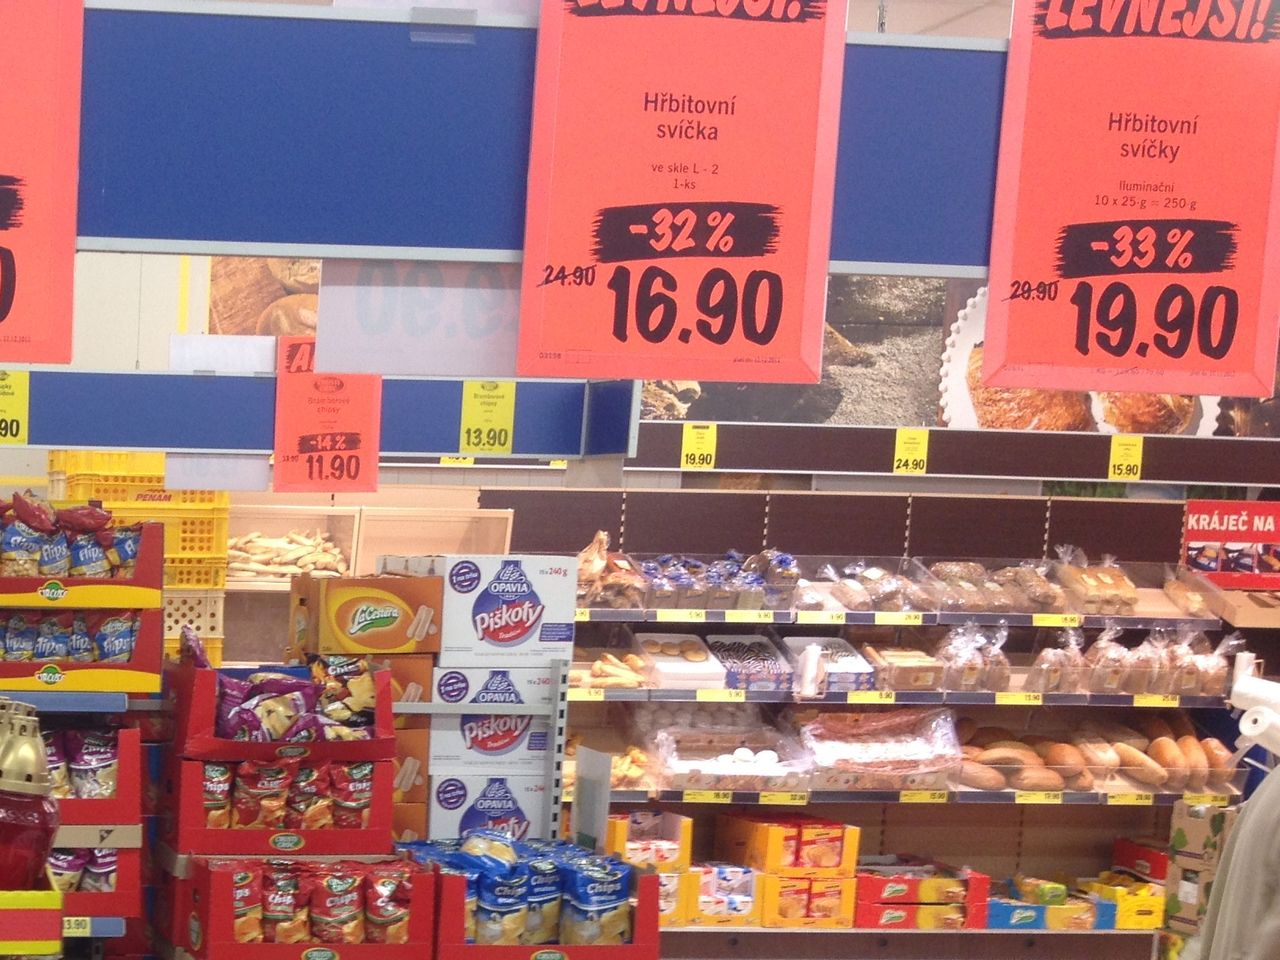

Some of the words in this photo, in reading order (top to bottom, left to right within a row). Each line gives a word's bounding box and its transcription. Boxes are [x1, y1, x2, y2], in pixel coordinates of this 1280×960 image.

[644, 92, 737, 116] Hřbitovní
[656, 119, 718, 141] svíčka
[1108, 112, 1199, 135] Hřbitovní
[1120, 139, 1180, 163] svíčky
[651, 165, 664, 174] ve
[667, 162, 689, 174] skle
[693, 163, 699, 174] L
[711, 164, 719, 175] 2
[1094, 195, 1109, 206] 10
[629, 208, 697, 252] -32
[706, 211, 734, 252] %
[1090, 225, 1157, 268] -33
[1165, 228, 1195, 269] %
[544, 264, 597, 287] 24.90
[607, 265, 783, 345] 16.90
[1070, 281, 1239, 360] 19.90
[465, 427, 508, 448] 13.90
[306, 454, 361, 481] 11.90
[685, 453, 712, 466] 19.90
[895, 458, 925, 470] 24.90
[1112, 463, 1139, 477] 15.90
[135, 493, 172, 502] PENAM
[1188, 510, 1249, 531] KRÁJEČ
[1253, 515, 1275, 532] NA
[491, 582, 528, 594] OPAVIA
[475, 600, 545, 641] Piškoty
[479, 692, 516, 703] OPAVIA
[477, 799, 514, 809] OPAVIA
[494, 885, 528, 898] Chips
[587, 881, 622, 895] Chips
